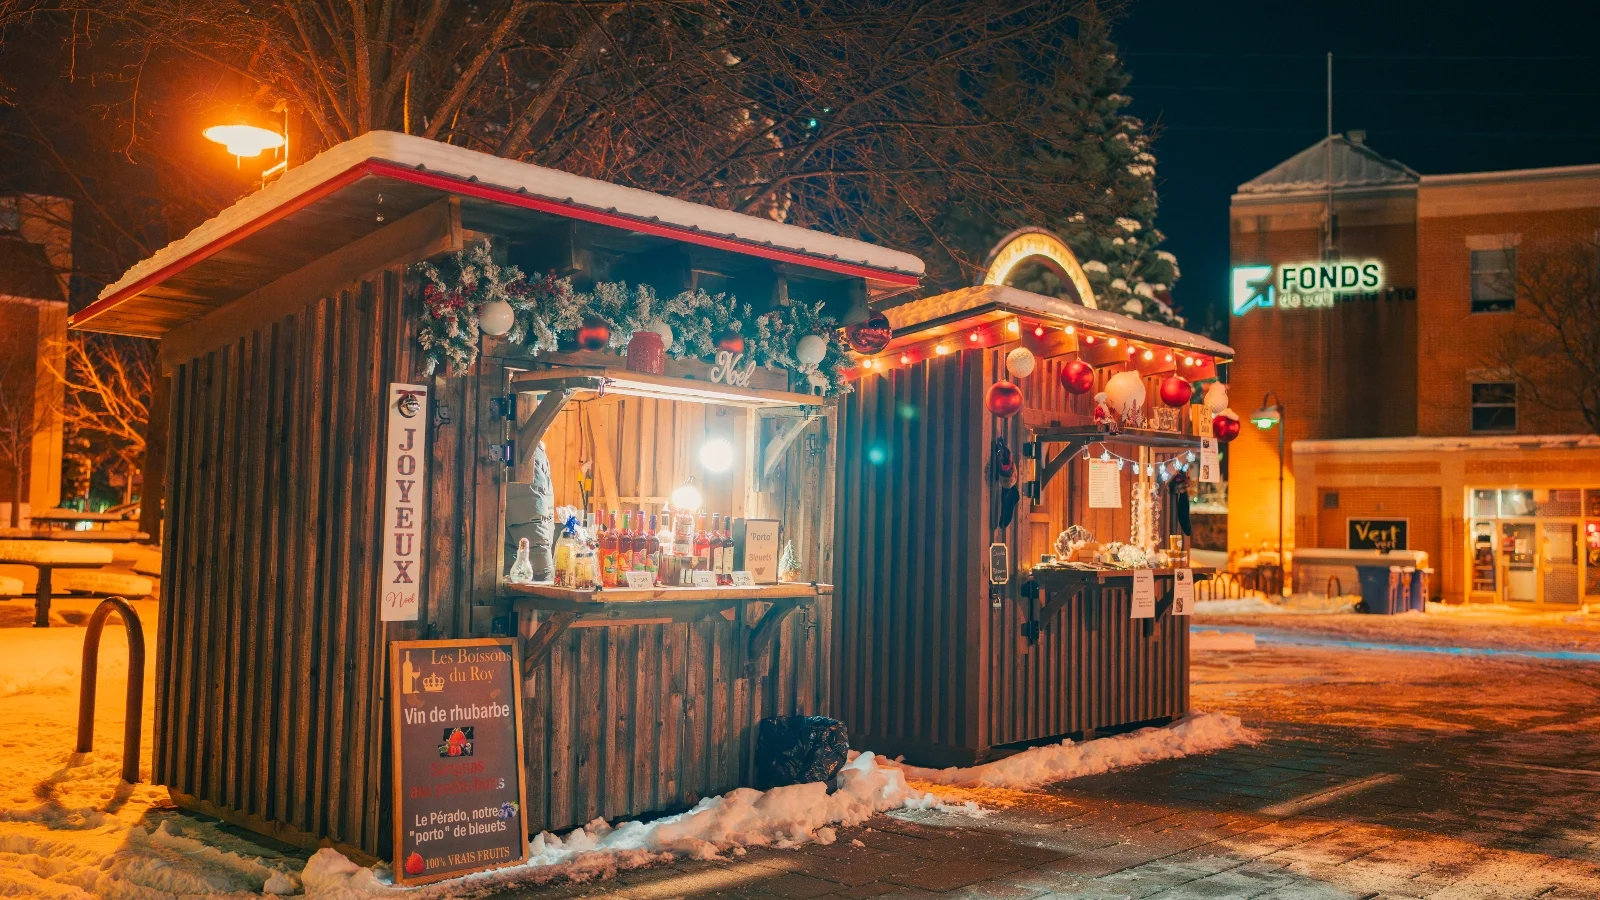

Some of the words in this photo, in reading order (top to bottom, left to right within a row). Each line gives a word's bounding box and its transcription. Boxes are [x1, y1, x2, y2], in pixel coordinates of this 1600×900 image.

[1282, 263, 1379, 290] FONDS
[1280, 291, 1301, 307] de
[392, 428, 417, 584] JOYEUX
[1355, 521, 1400, 543] Vert
[431, 649, 453, 665] Les
[457, 648, 512, 664] Boissons
[449, 667, 466, 683] du
[470, 666, 495, 684] Roy
[404, 708, 426, 725] Vin
[429, 706, 447, 723] de
[450, 702, 510, 721] rhubarbe
[415, 814, 428, 827] Le
[430, 809, 470, 825] Pérado,
[472, 806, 499, 820] notre
[409, 826, 450, 845] "porto"
[453, 825, 467, 838] de
[469, 820, 507, 836] bleuets
[425, 857, 446, 870] 100%
[448, 852, 476, 866] VRAIS
[477, 846, 510, 862] FRUITS
